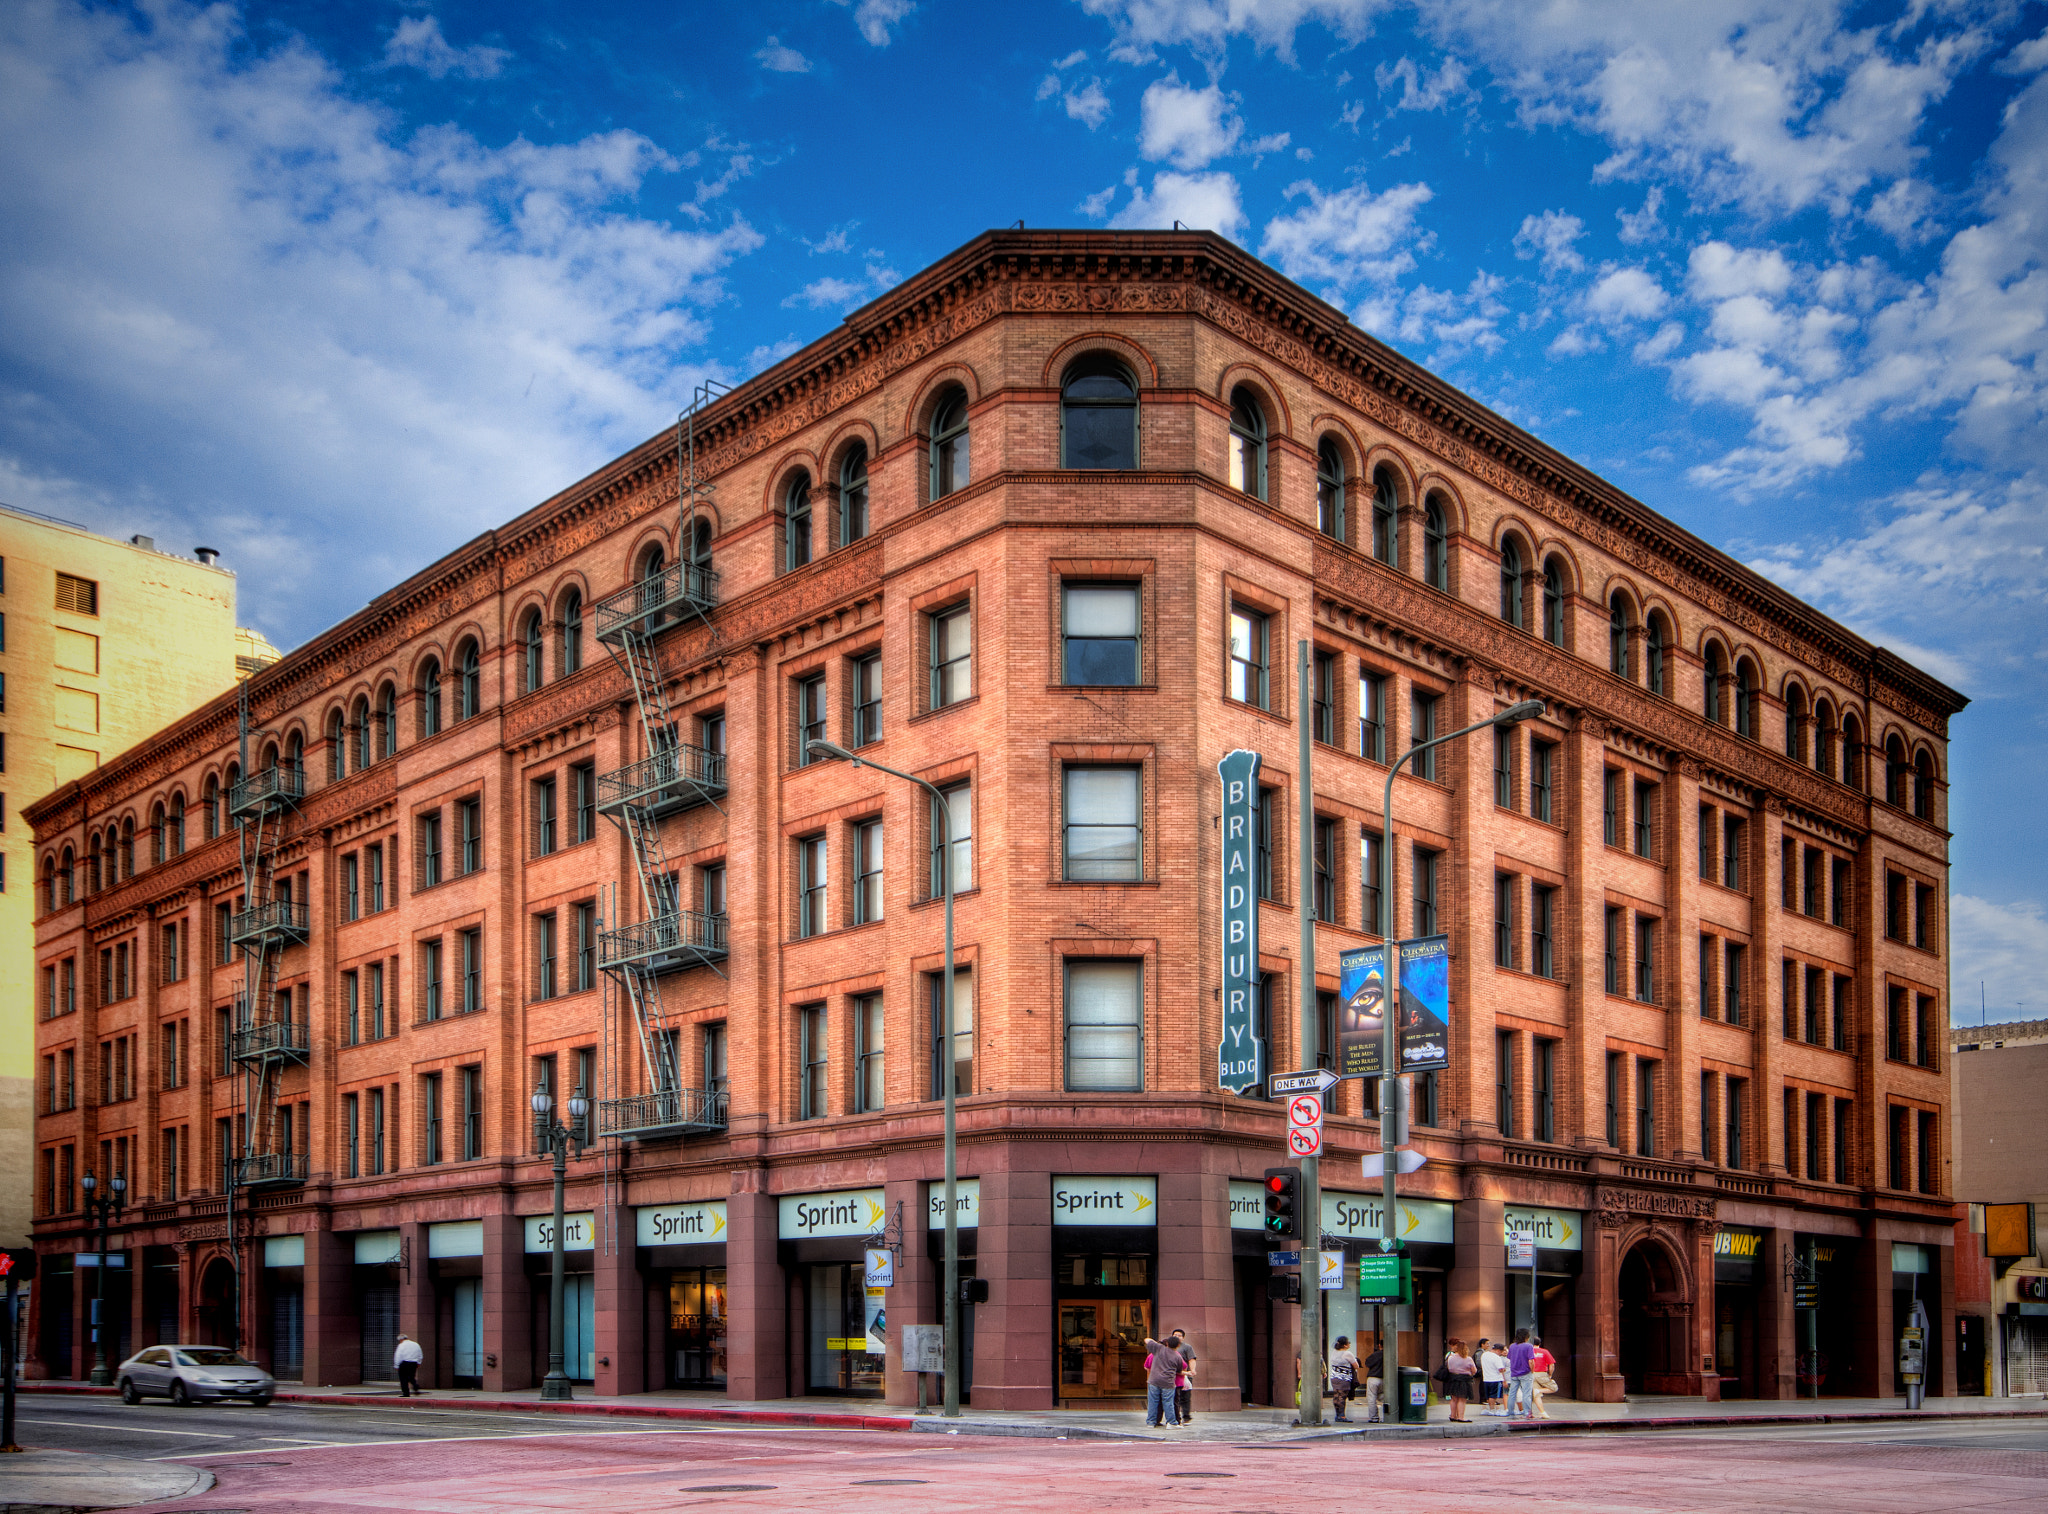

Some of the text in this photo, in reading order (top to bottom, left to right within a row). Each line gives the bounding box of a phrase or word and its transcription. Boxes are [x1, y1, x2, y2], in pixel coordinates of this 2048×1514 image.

[1229, 780, 1246, 1048] BRADBURY
[1342, 953, 1383, 967] CLEOPATRA
[1401, 943, 1445, 957] CLEOPATRA
[1221, 1059, 1255, 1076] BLDG
[1277, 1077, 1317, 1089] ONE WAY
[931, 1194, 970, 1216] Spnt
[1056, 1190, 1124, 1213] Sprint
[1229, 1197, 1261, 1216] print
[1626, 1192, 1692, 1214] BRADBURY
[653, 1210, 703, 1241] Sprint
[797, 1199, 858, 1233] Sprint
[1336, 1200, 1383, 1233] Sprin
[191, 1224, 228, 1239] BRADBUR
[538, 1220, 581, 1248] Spnt
[1714, 1232, 1761, 1256] UBWAY
[1291, 1251, 1299, 1260] St
[867, 1273, 891, 1283] Sprint
[1320, 1276, 1341, 1286] print
